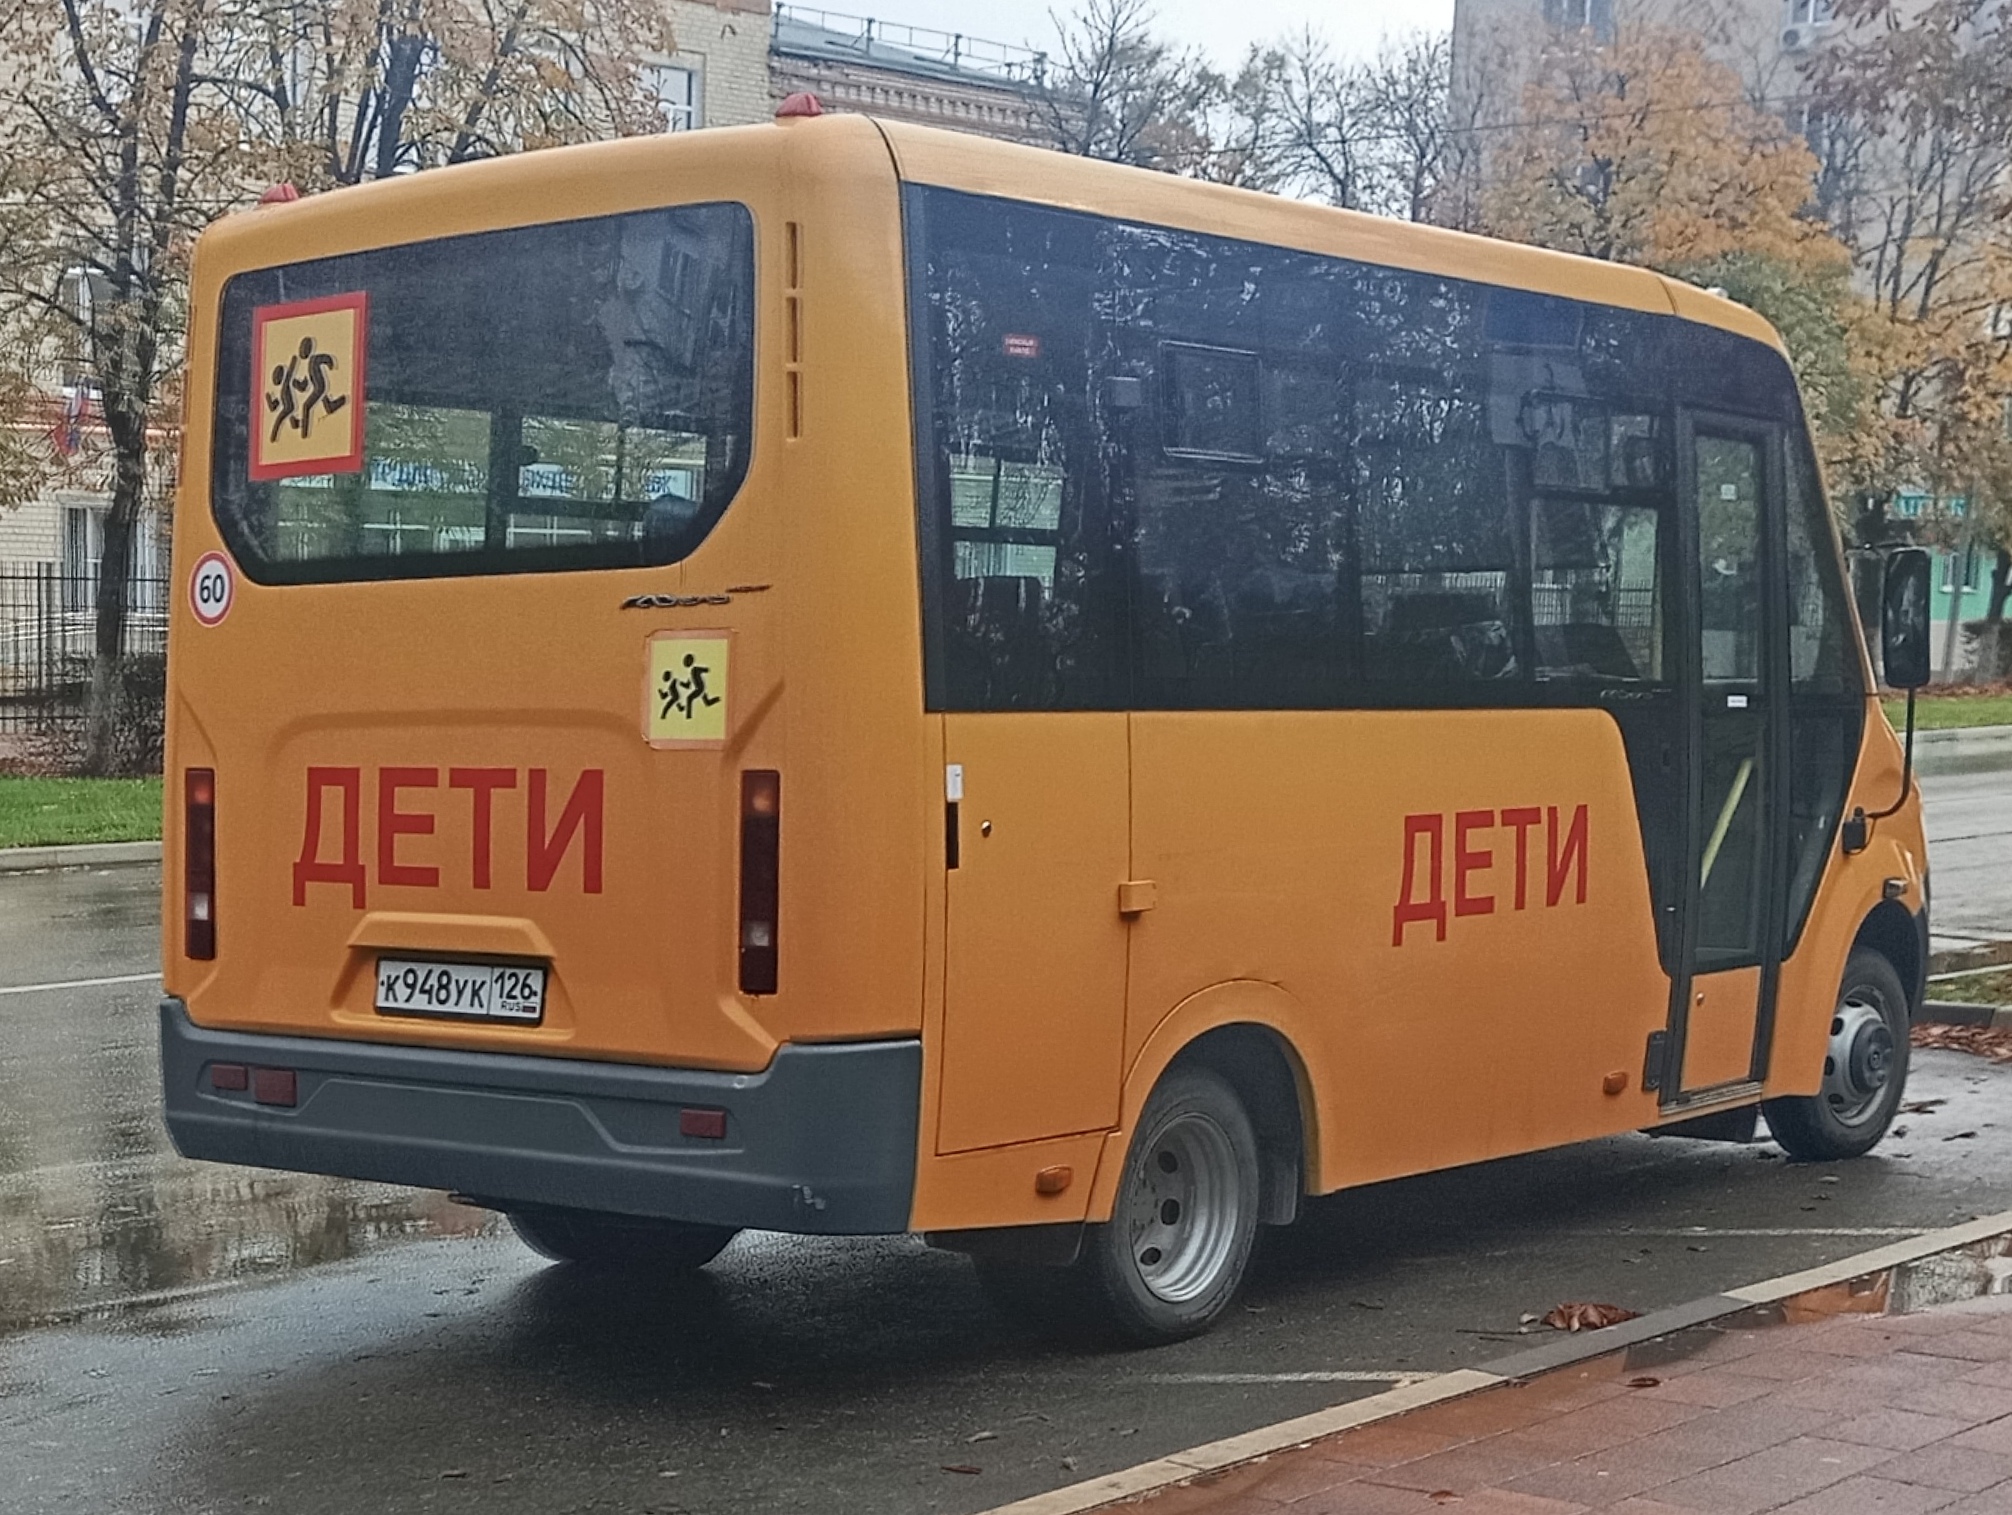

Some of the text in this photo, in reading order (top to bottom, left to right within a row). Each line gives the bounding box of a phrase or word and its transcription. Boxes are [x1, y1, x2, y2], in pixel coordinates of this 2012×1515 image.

[200, 574, 225, 603] 60
[293, 767, 604, 909] ДЕТИ
[1392, 804, 1588, 947] ДЕТИ
[494, 970, 533, 1000] 126
[501, 1001, 522, 1011] RUS
